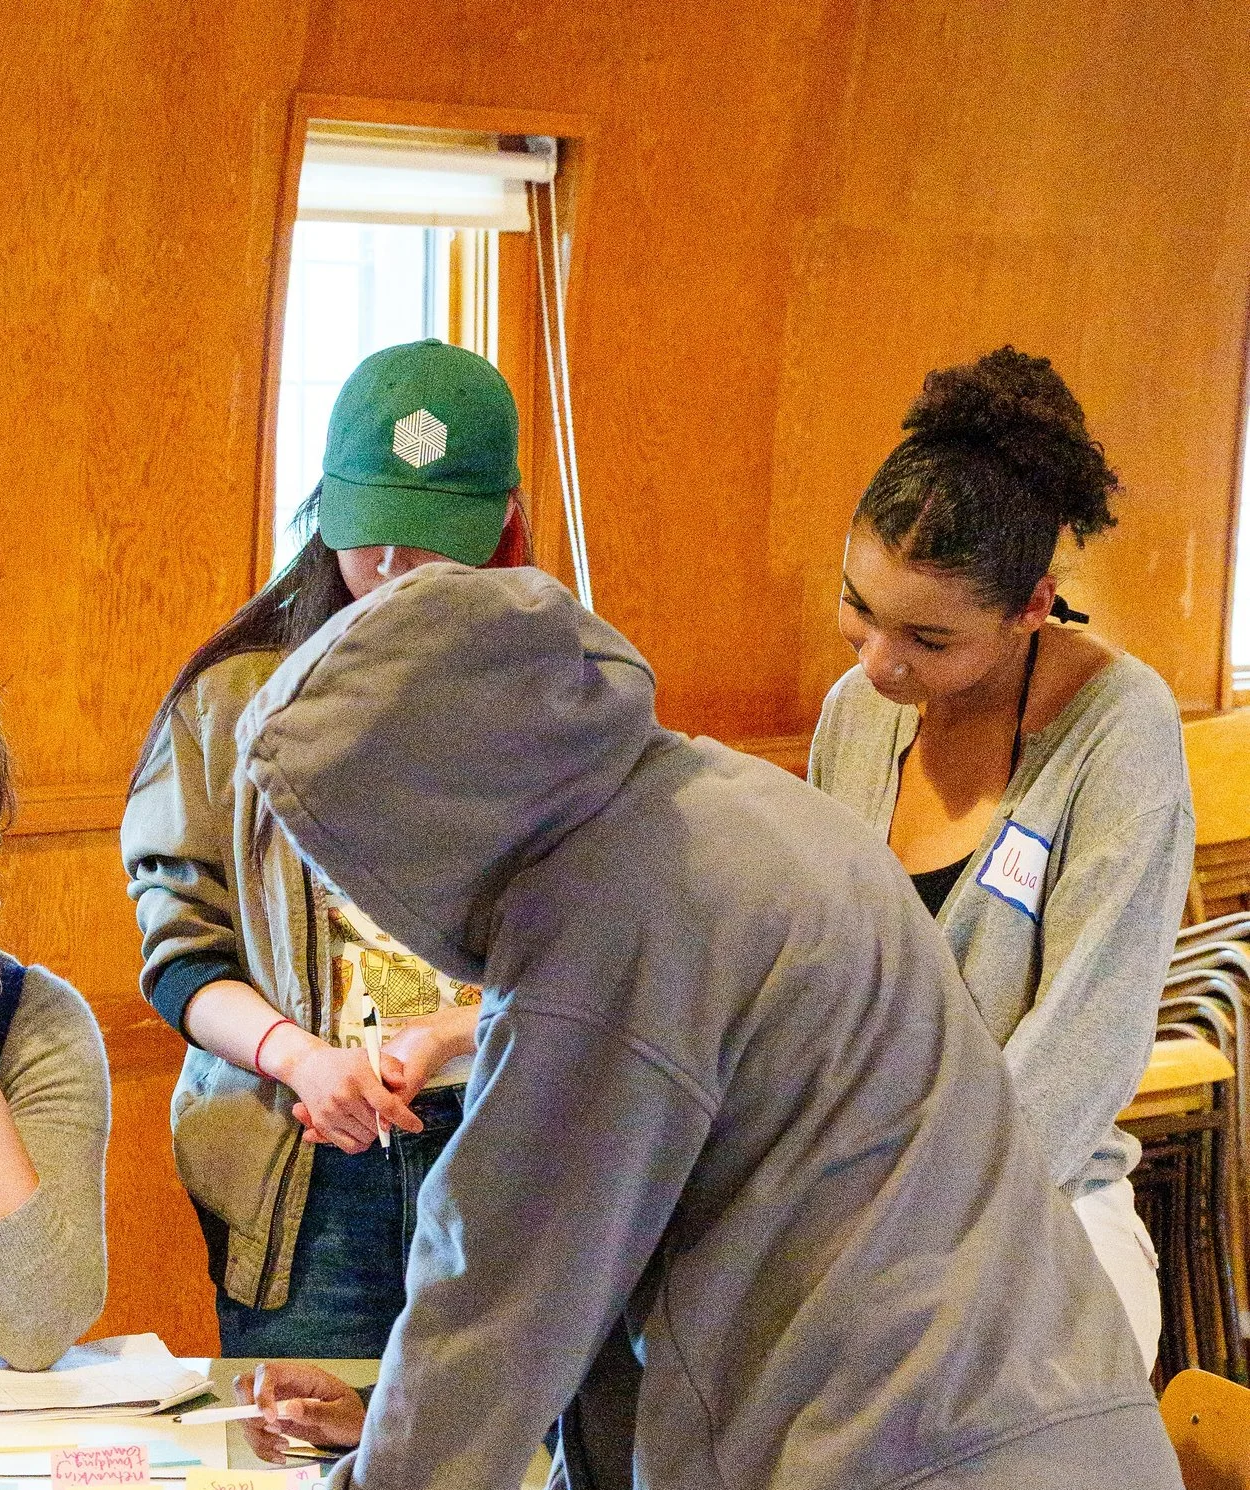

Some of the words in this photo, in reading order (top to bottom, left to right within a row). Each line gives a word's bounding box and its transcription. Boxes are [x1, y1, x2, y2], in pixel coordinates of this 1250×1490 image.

[1002, 847, 1038, 890] Uwa
[55, 1460, 144, 1485] networking
[74, 1456, 133, 1471] building
